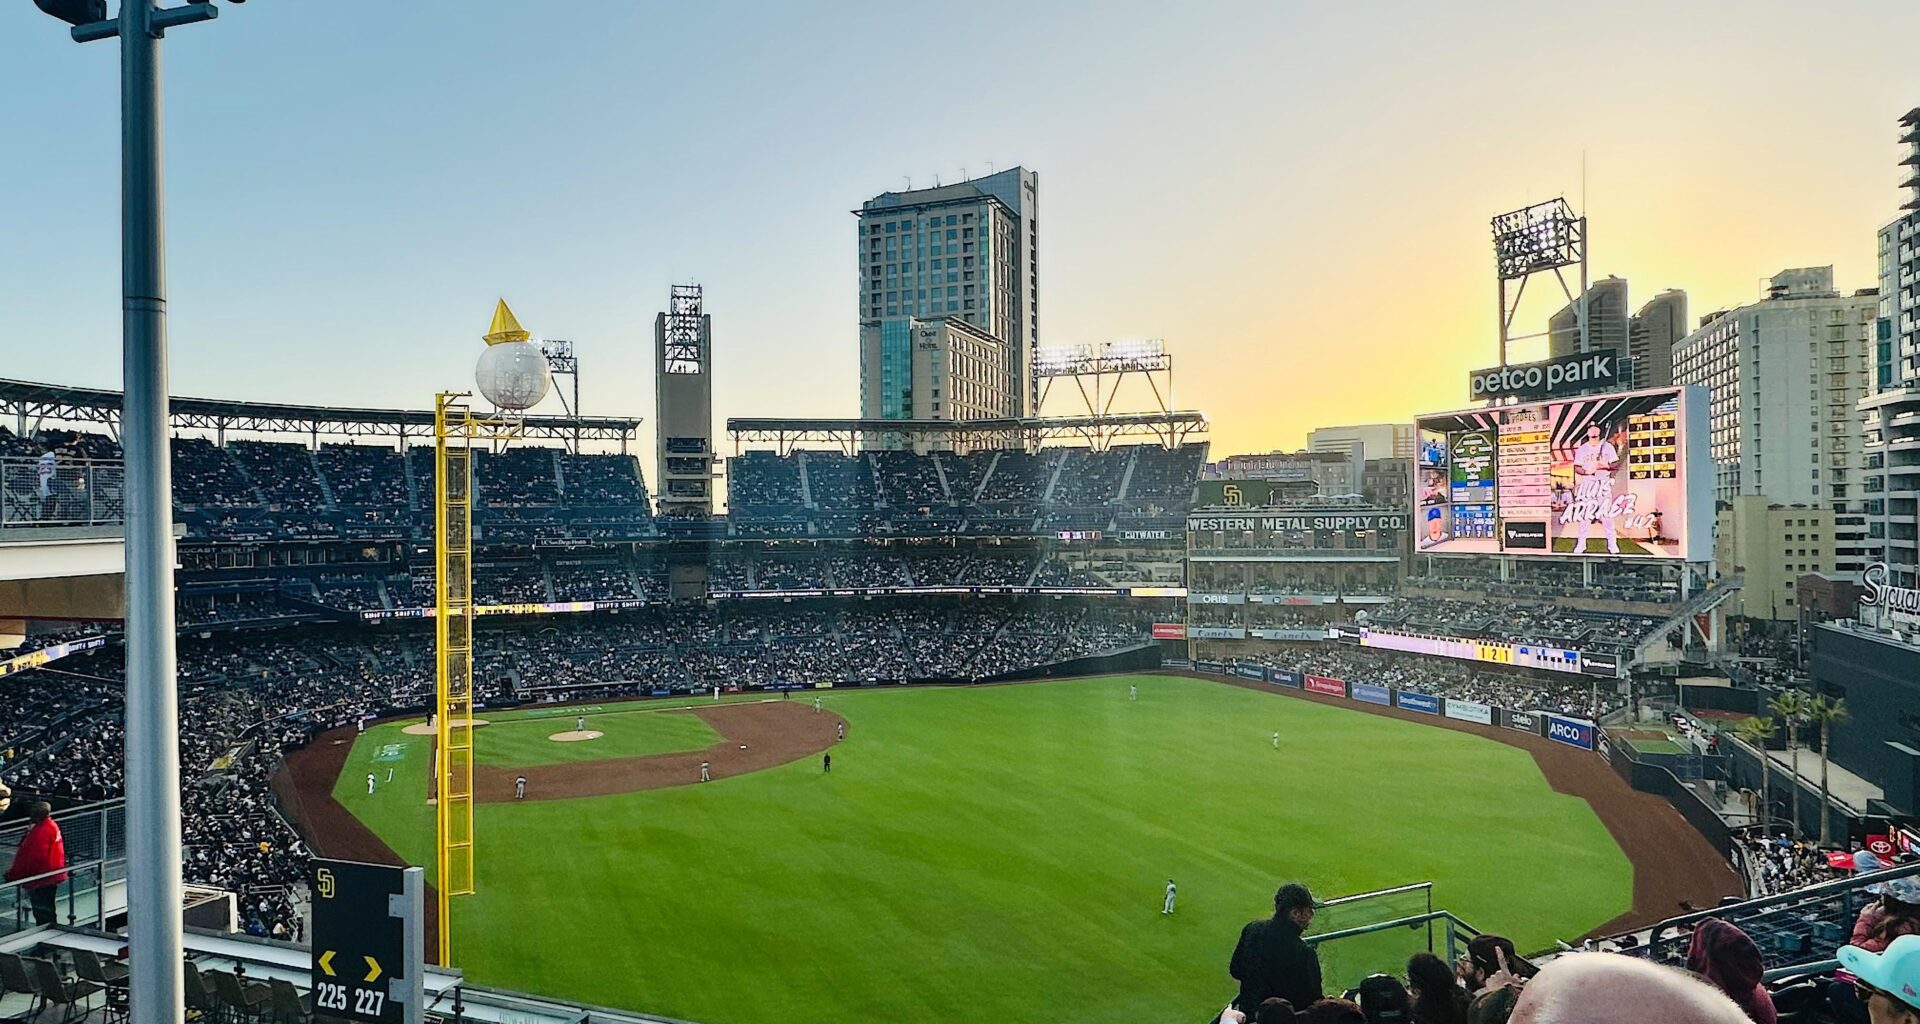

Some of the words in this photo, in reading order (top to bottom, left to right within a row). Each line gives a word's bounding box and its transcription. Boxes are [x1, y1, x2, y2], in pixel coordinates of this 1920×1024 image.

[1471, 366, 1543, 396] petco
[1546, 355, 1612, 391] park
[1576, 477, 1615, 501] LUIS
[1560, 493, 1637, 525] ARRAEZ
[1188, 518, 1255, 531] WESTERN
[1262, 517, 1310, 530] METAL
[1313, 516, 1372, 530] SUPPLY
[1378, 516, 1405, 529] CO.
[1125, 530, 1165, 539] CUTWATER
[1203, 595, 1229, 604] ORIS
[1492, 649, 1497, 660] 2
[1511, 712, 1532, 726] stelo
[1550, 721, 1580, 741] ARCO
[317, 868, 335, 899] SD
[317, 981, 347, 1010] 225
[355, 988, 384, 1016] 227
